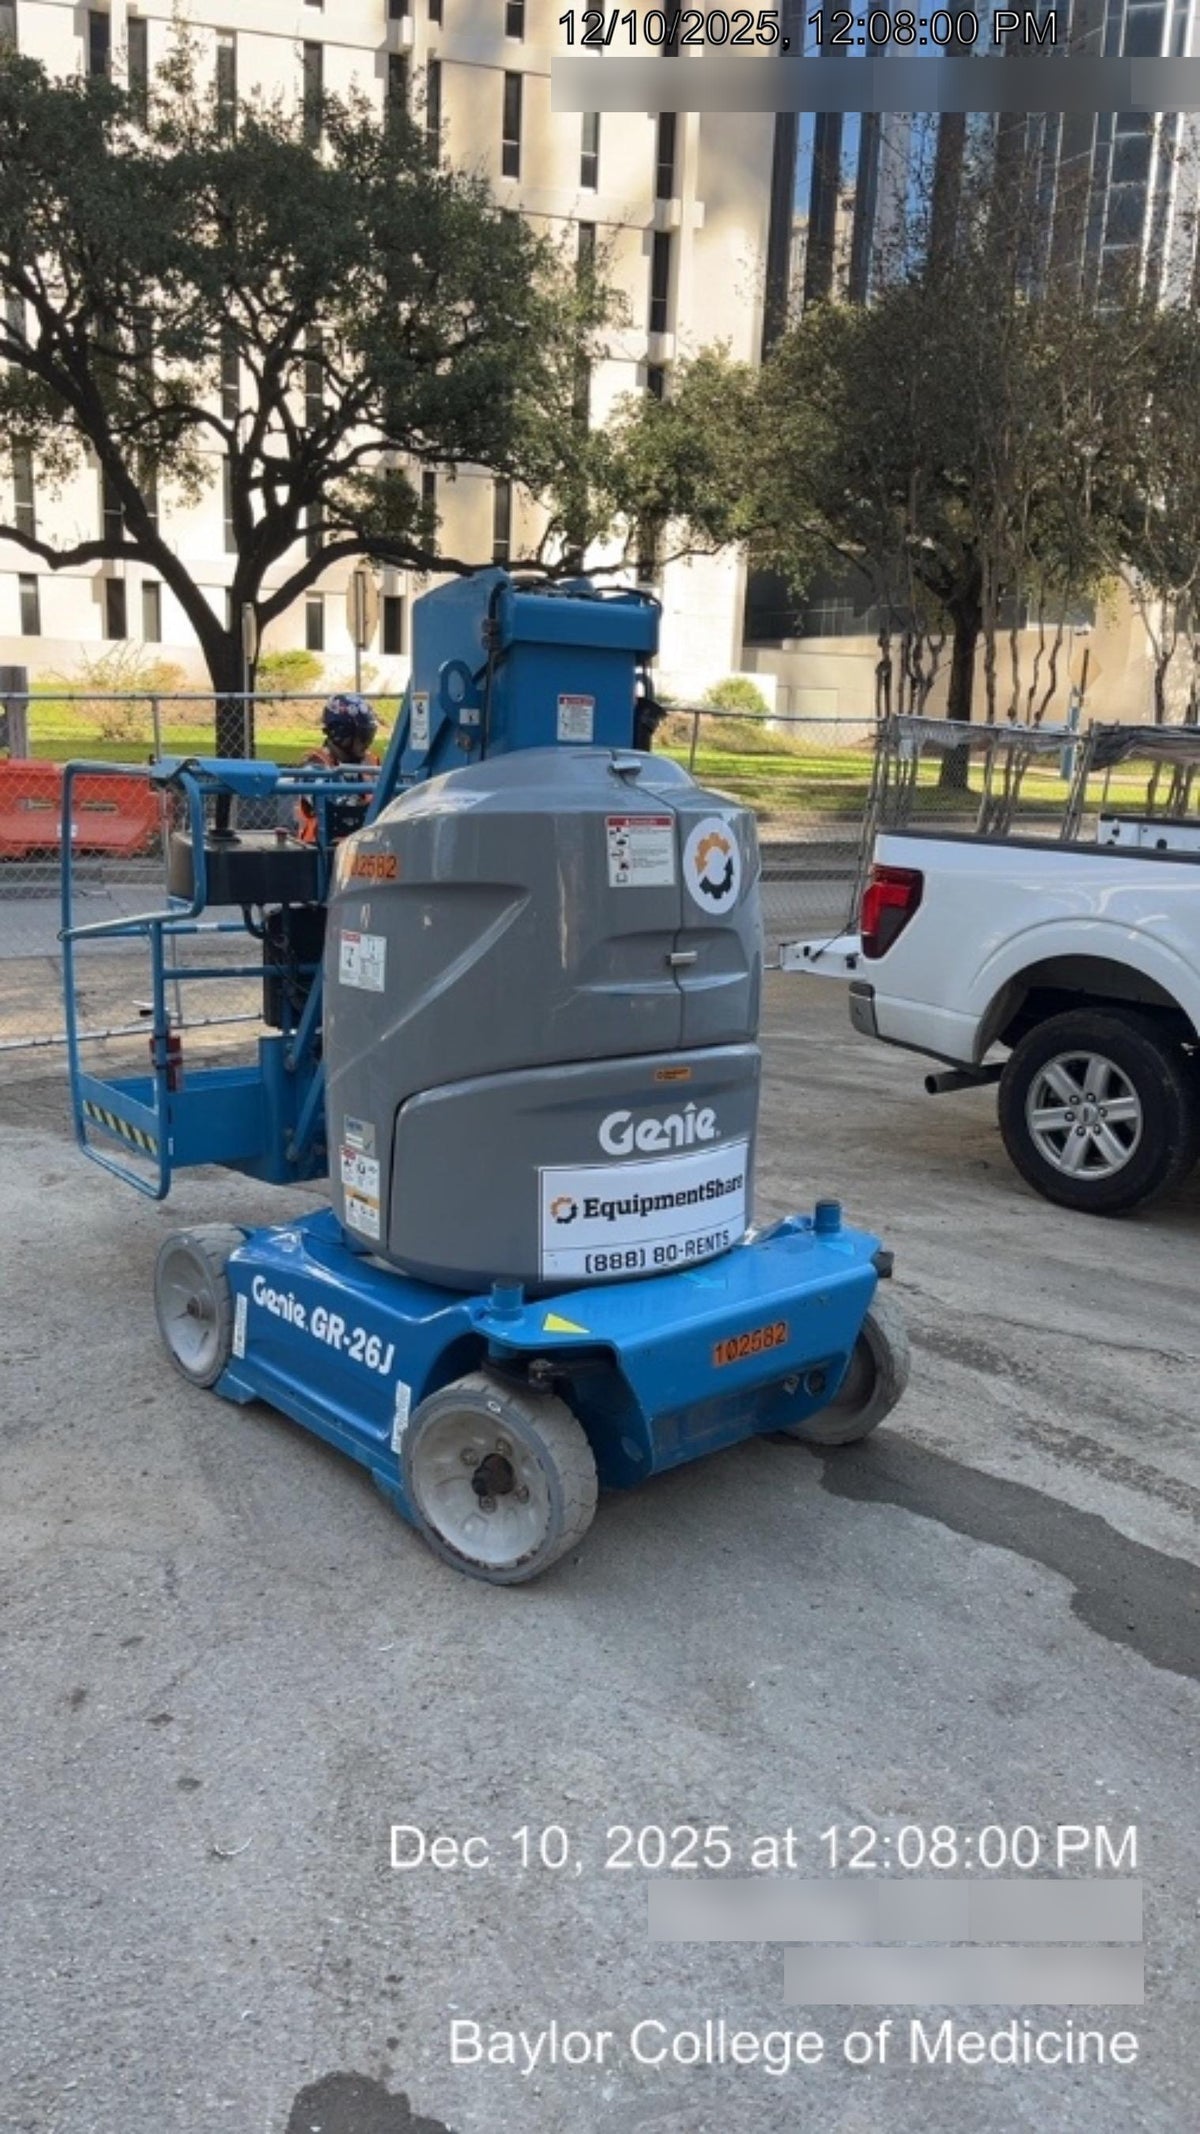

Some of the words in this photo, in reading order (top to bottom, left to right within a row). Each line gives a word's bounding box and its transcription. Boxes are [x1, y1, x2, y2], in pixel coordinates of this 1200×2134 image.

[599, 1102, 717, 1156] Genie
[585, 1249, 646, 1274] (888)
[653, 1230, 730, 1265] 80-RENTS
[252, 1274, 307, 1331] Genie
[310, 1306, 396, 1376] GR-26J
[715, 1321, 786, 1364] 102582
